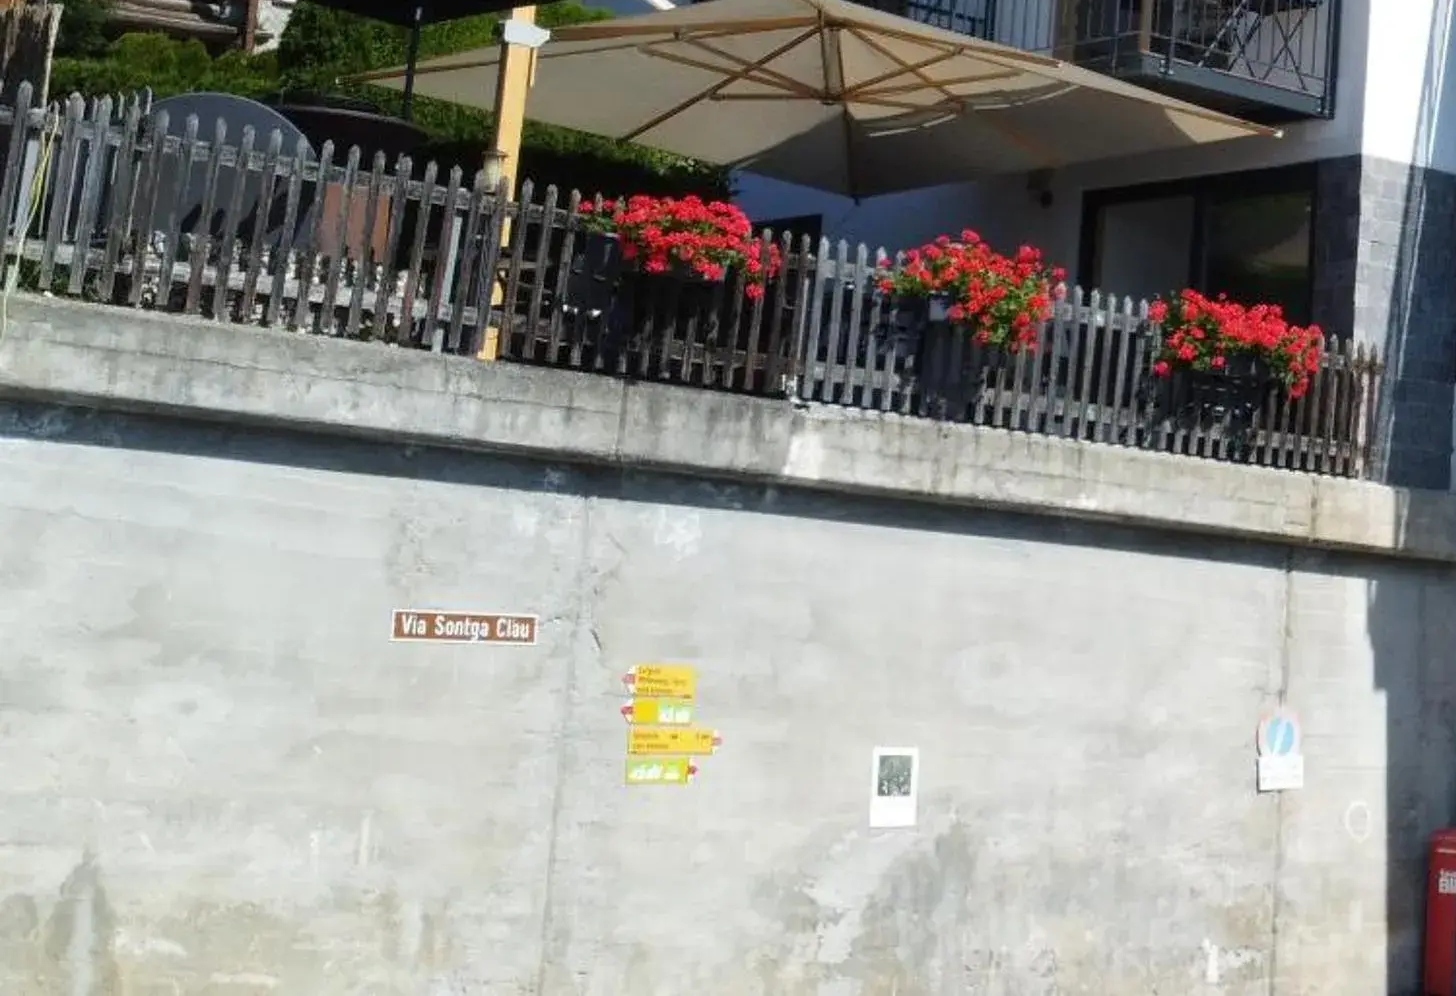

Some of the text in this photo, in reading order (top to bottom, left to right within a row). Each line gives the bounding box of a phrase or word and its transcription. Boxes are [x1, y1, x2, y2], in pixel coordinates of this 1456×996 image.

[401, 613, 530, 641] Via Sontga Clau
